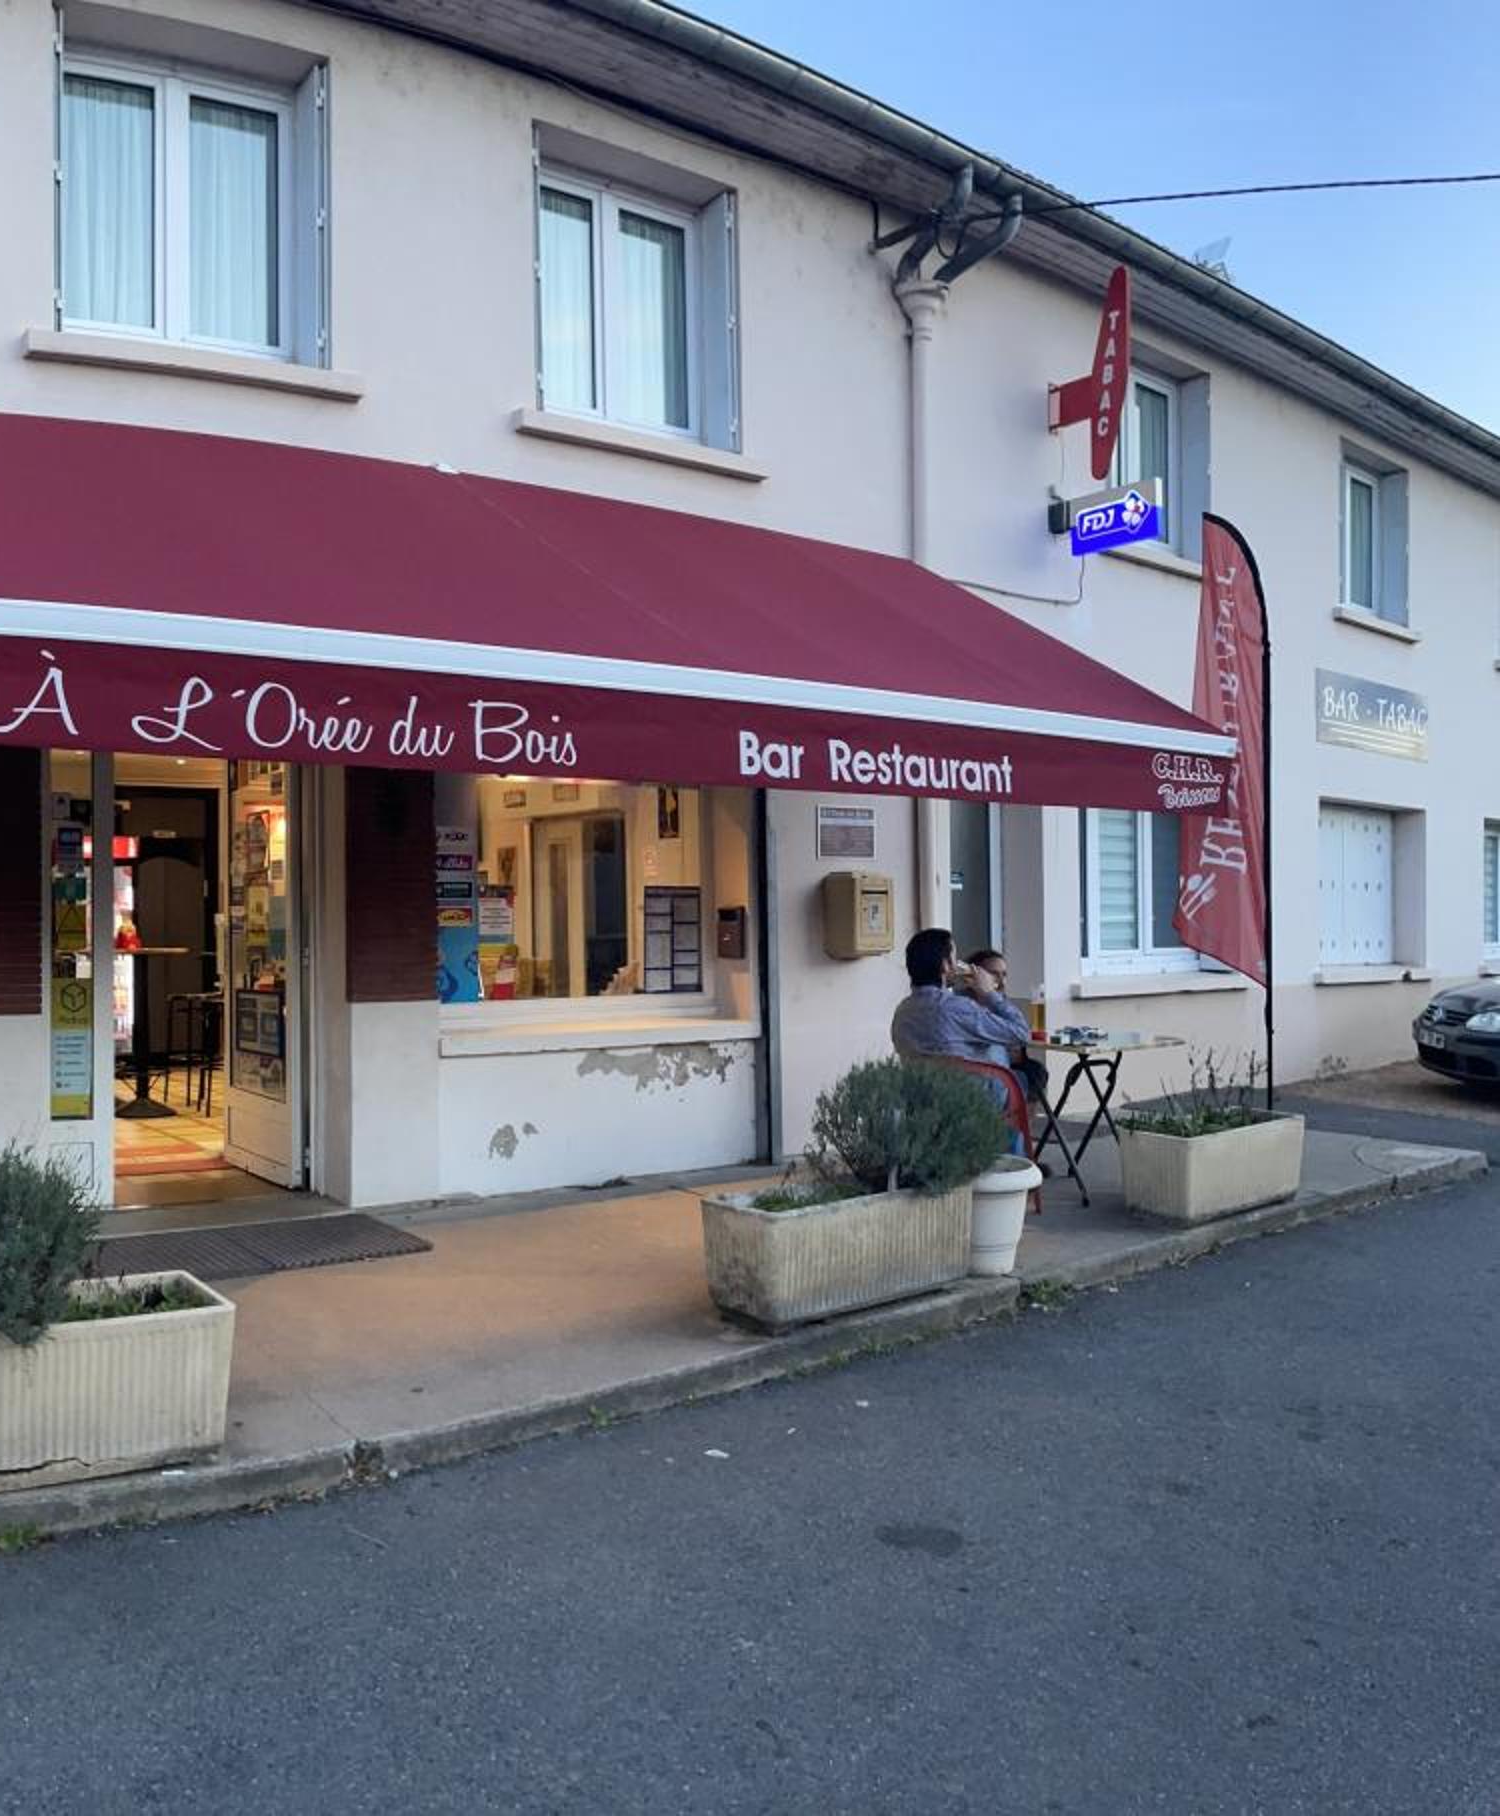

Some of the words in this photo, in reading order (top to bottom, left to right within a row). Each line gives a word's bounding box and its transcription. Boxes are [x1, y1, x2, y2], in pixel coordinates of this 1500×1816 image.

[1097, 311, 1120, 436] TABAC
[1081, 509, 1115, 534] FDJ
[389, 696, 455, 757] du
[468, 699, 578, 767] Bois
[1323, 685, 1360, 721] BAR
[1376, 698, 1429, 736] TABAC
[739, 731, 804, 780] Bar
[828, 738, 1014, 794] Restaurant
